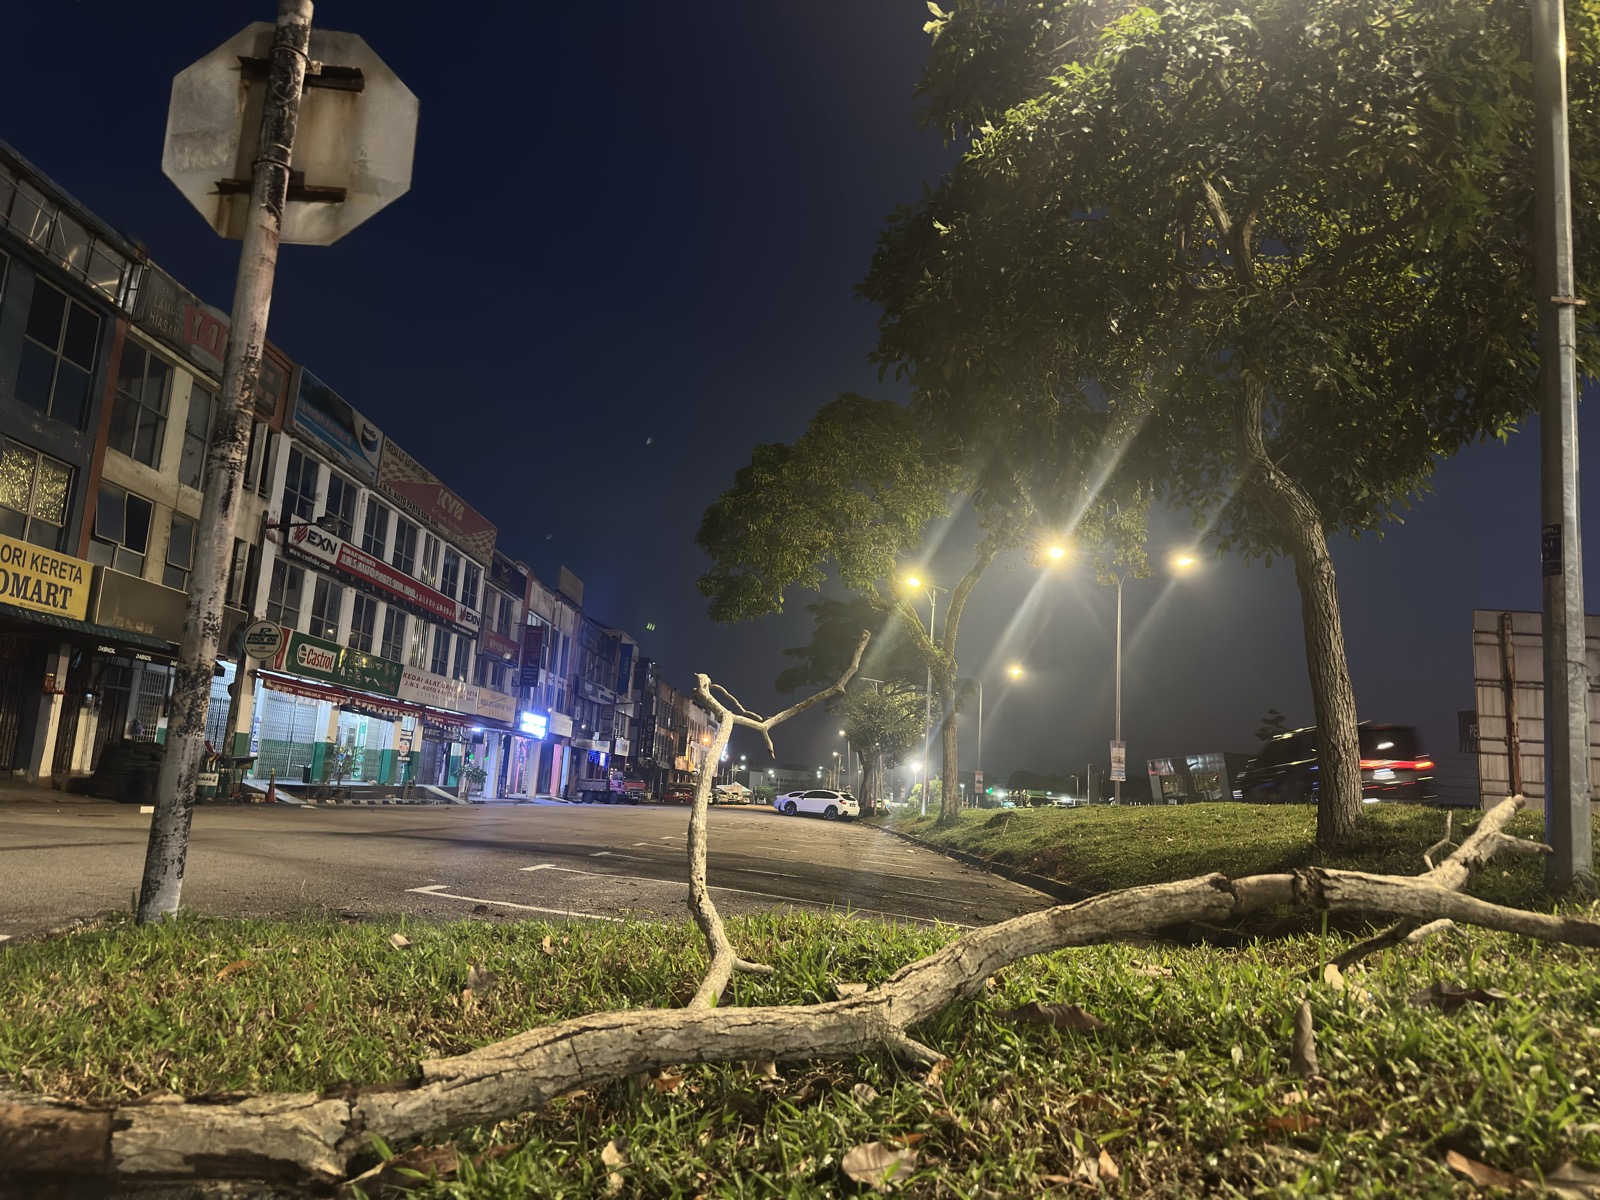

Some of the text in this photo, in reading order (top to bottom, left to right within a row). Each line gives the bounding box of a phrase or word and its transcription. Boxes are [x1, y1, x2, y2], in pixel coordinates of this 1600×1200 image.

[306, 529, 338, 555] EXN
[0, 544, 27, 568] ORI
[30, 552, 82, 585] KERETA
[306, 648, 335, 671] Castrol
[403, 672, 424, 683] KEDAI
[424, 678, 440, 688] ALAT
[422, 685, 437, 693] AUTO
